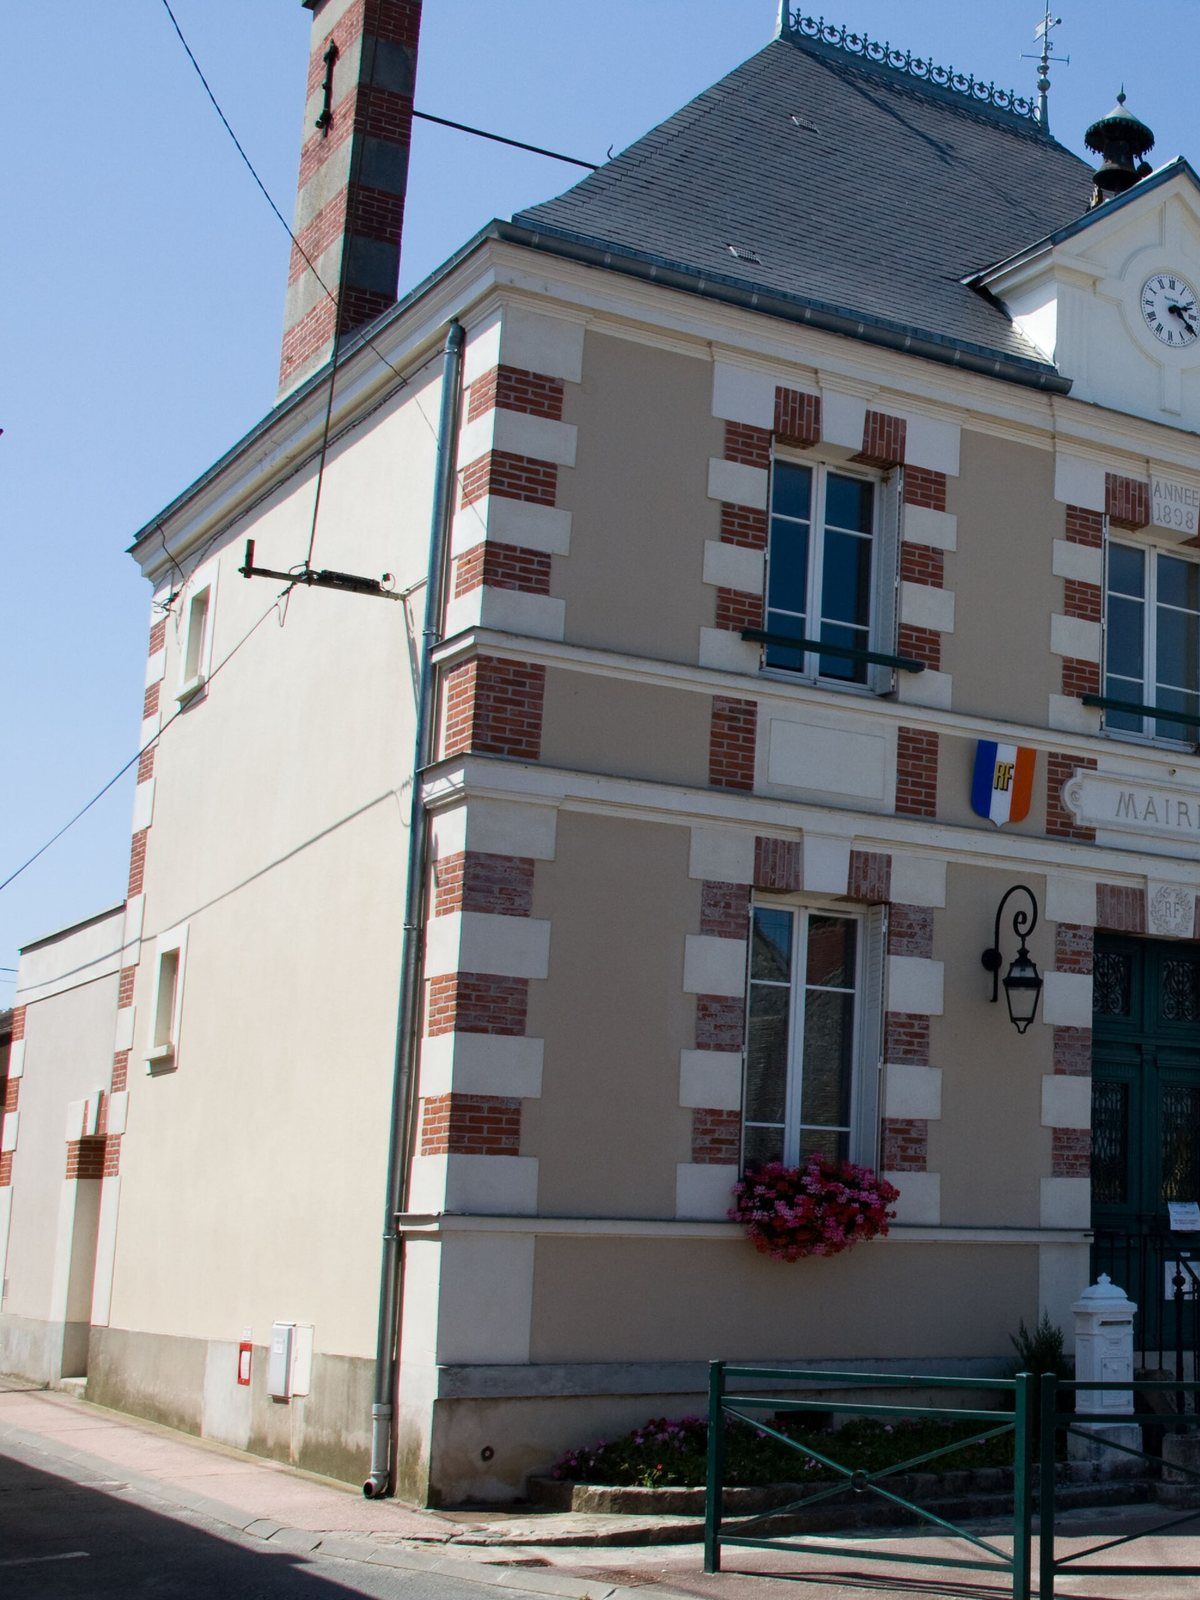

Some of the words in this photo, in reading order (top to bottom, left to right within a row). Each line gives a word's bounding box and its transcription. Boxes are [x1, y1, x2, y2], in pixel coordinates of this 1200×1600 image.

[1153, 481, 1199, 508] ANNEE
[1155, 502, 1194, 530] 1898
[993, 760, 1015, 792] RF
